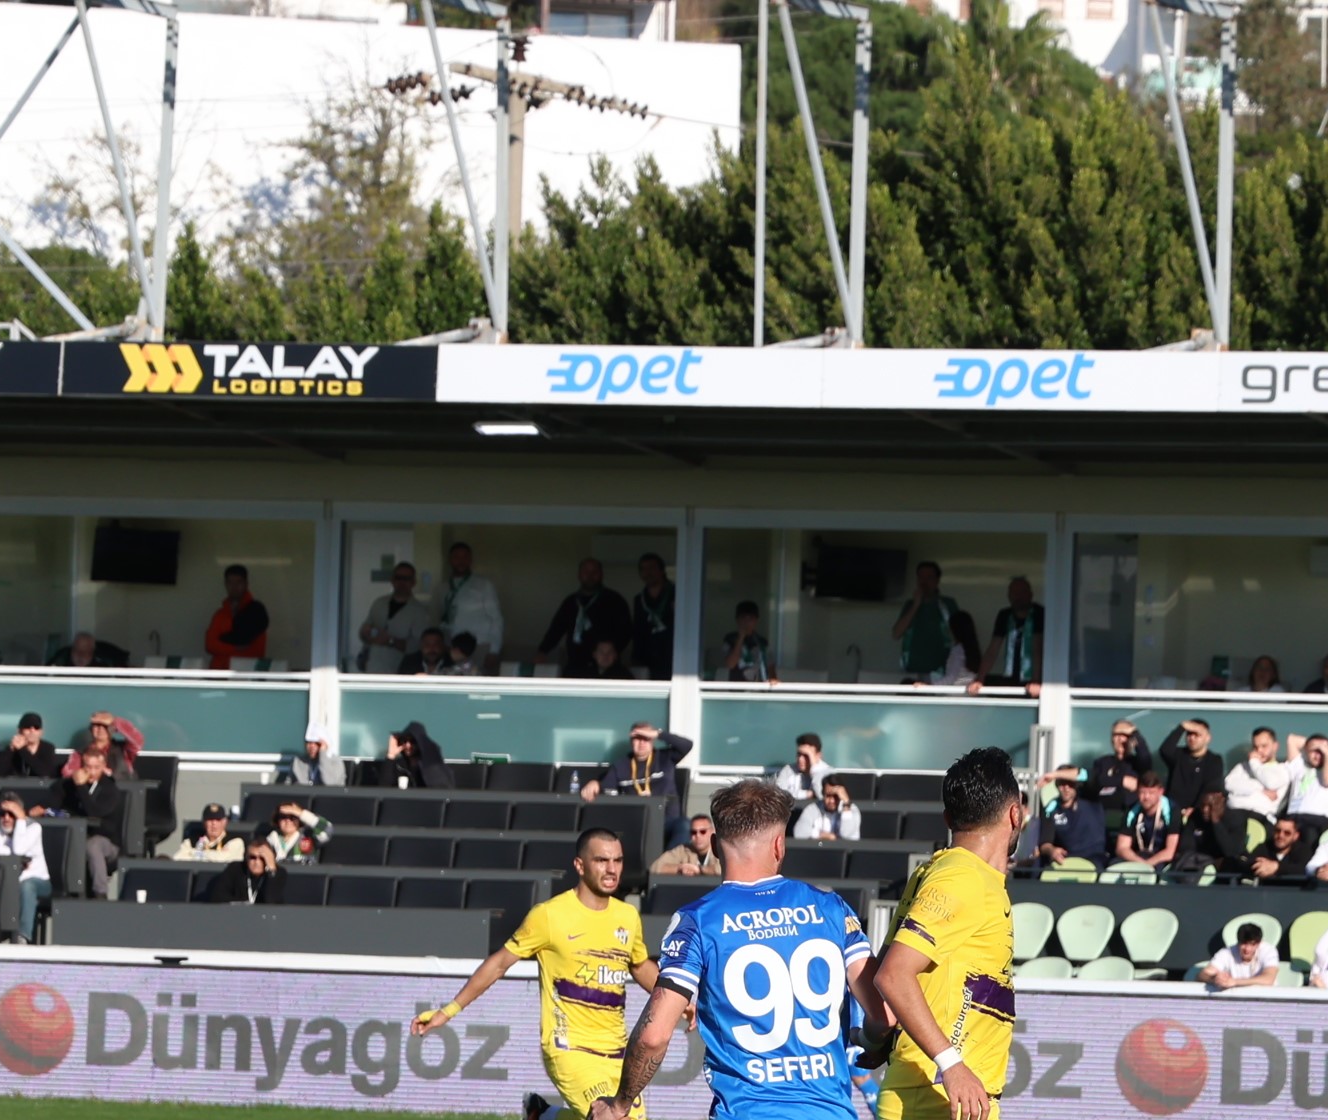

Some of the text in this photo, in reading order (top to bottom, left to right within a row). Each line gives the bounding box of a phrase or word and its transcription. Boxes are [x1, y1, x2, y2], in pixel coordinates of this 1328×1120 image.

[203, 344, 379, 379] TALAY
[556, 349, 702, 402] opet
[212, 379, 364, 396] LOGISTICS
[944, 353, 1095, 406] opet
[721, 904, 824, 934] ACROPOL
[748, 924, 799, 941] BODRUM
[723, 938, 846, 1054] 99
[85, 991, 511, 1097] Dünyagöz
[746, 1052, 835, 1083] SEFERI
